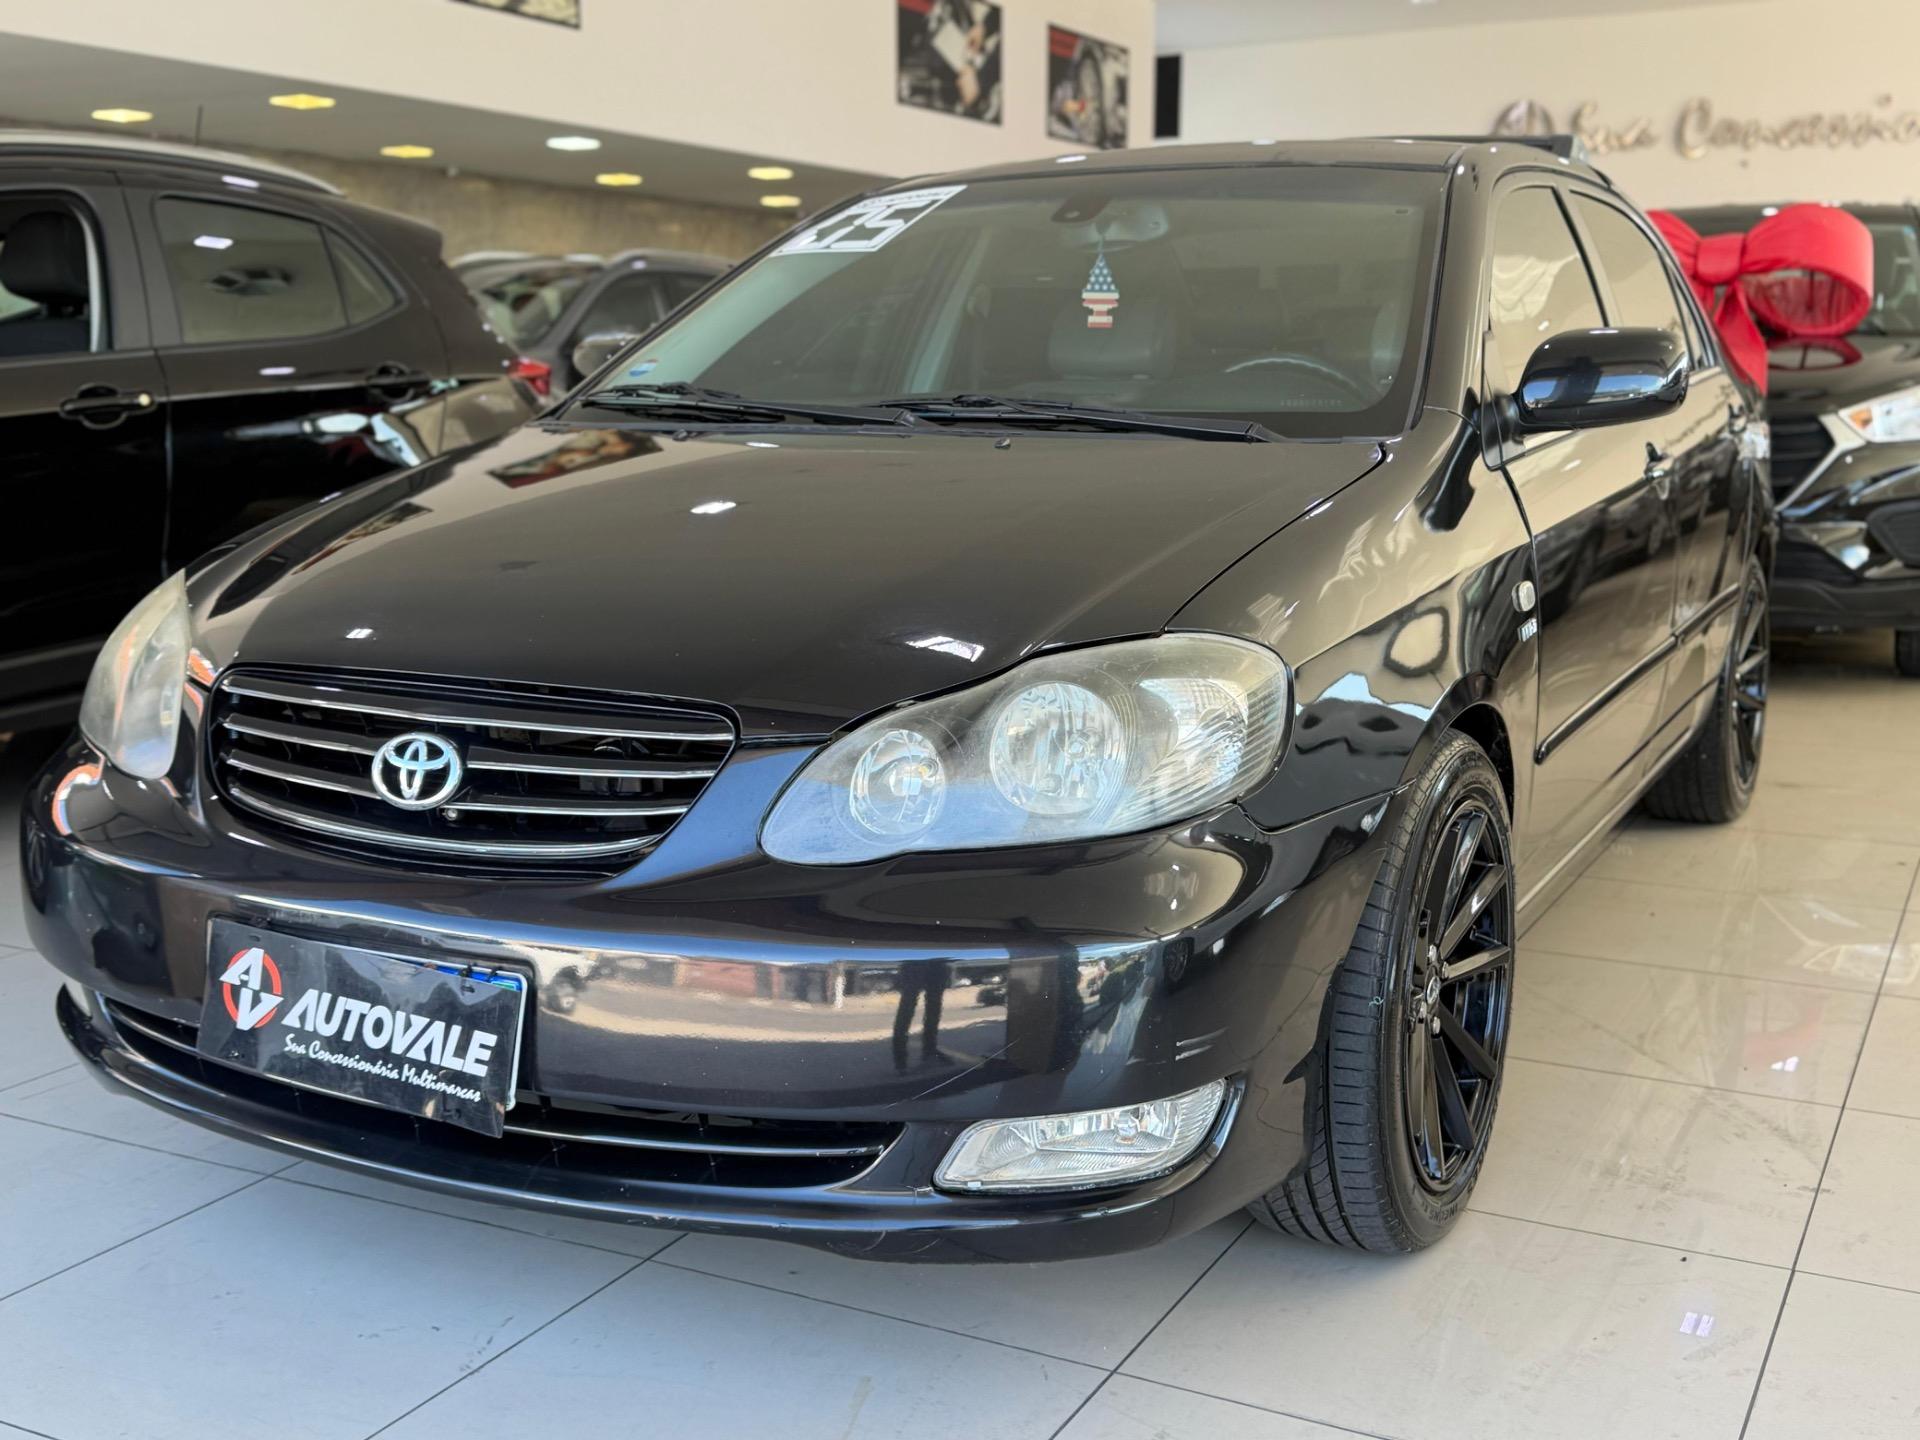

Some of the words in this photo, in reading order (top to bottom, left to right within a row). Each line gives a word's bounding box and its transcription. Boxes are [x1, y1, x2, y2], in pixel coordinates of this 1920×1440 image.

[281, 988, 498, 1076] AUTOVALE
[283, 1033, 307, 1055] Sua
[401, 1063, 481, 1103] Multimarcas
